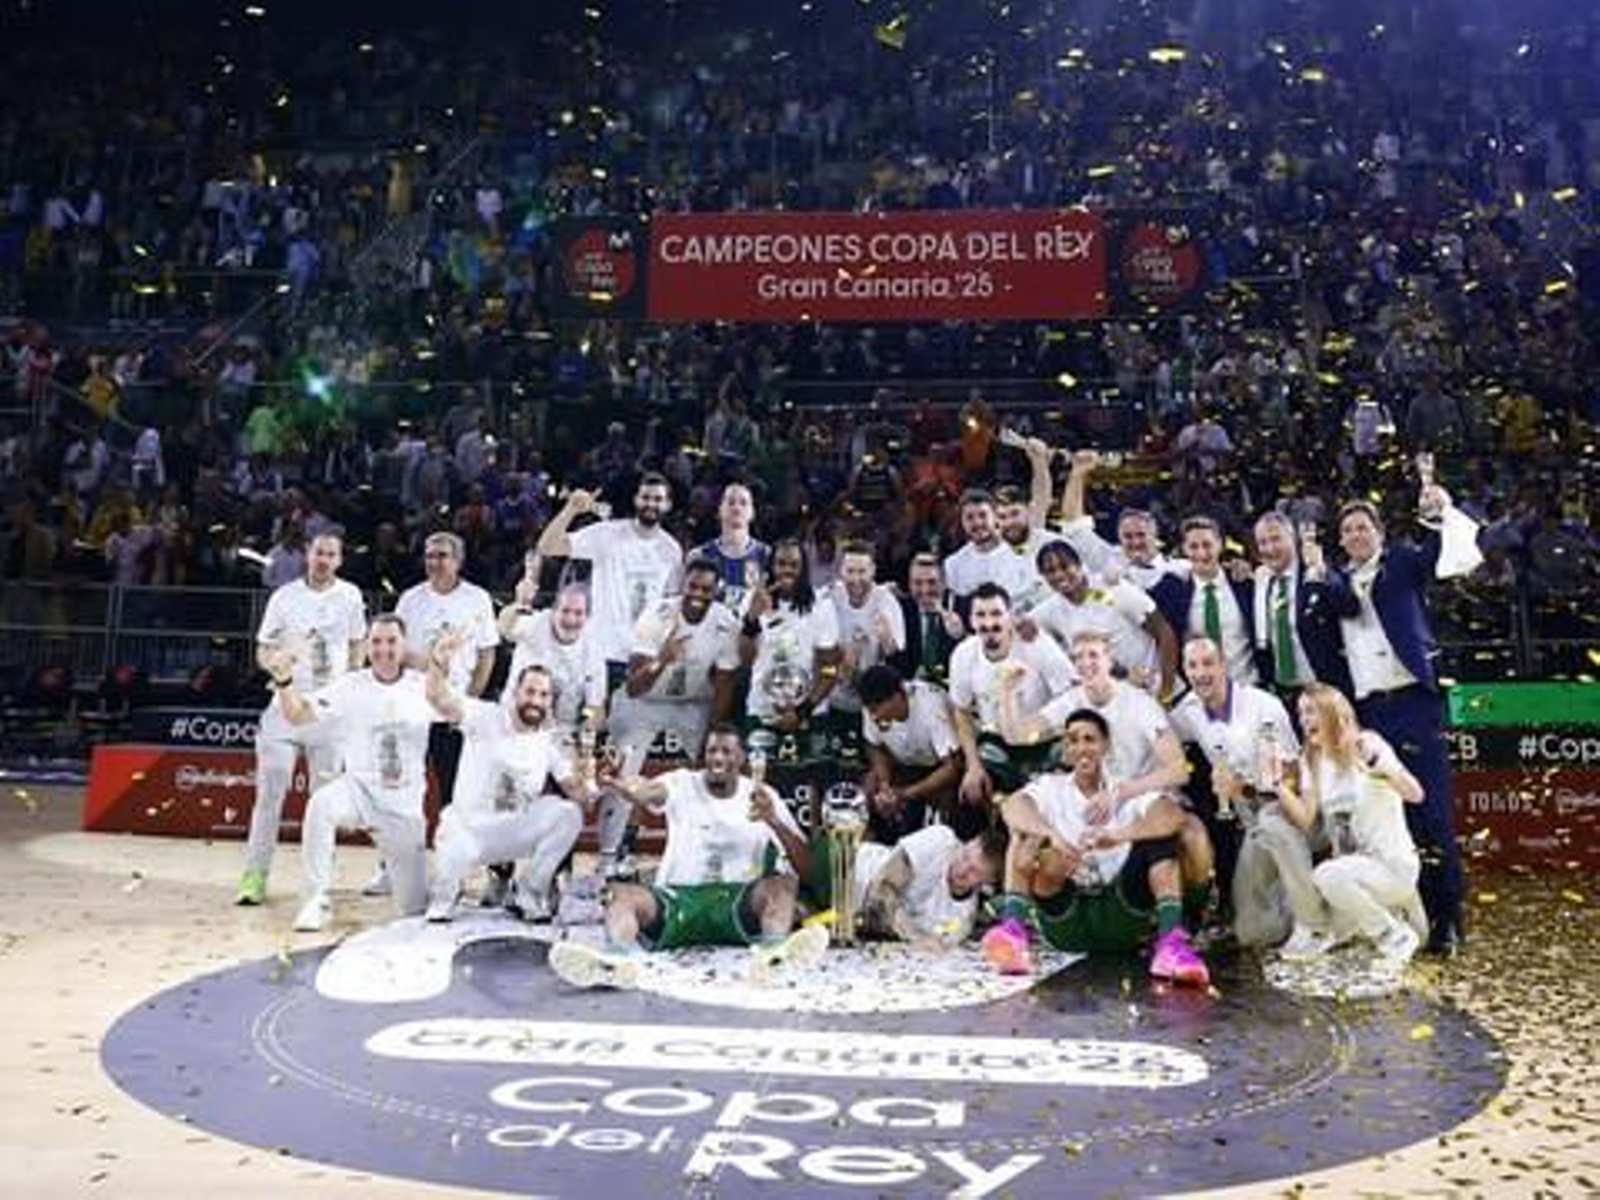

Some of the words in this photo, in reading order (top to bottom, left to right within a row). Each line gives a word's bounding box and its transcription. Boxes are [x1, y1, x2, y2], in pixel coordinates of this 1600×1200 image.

[660, 234, 862, 263] CAMPEONES
[868, 231, 959, 263] COPA
[967, 231, 1027, 260] DEL
[758, 275, 828, 298] Gran
[834, 271, 950, 298] Canaria
[406, 1030, 627, 1056] Gran
[489, 1076, 966, 1127] Copa
[488, 1122, 675, 1152] del
[683, 1131, 1047, 1200] Rey
